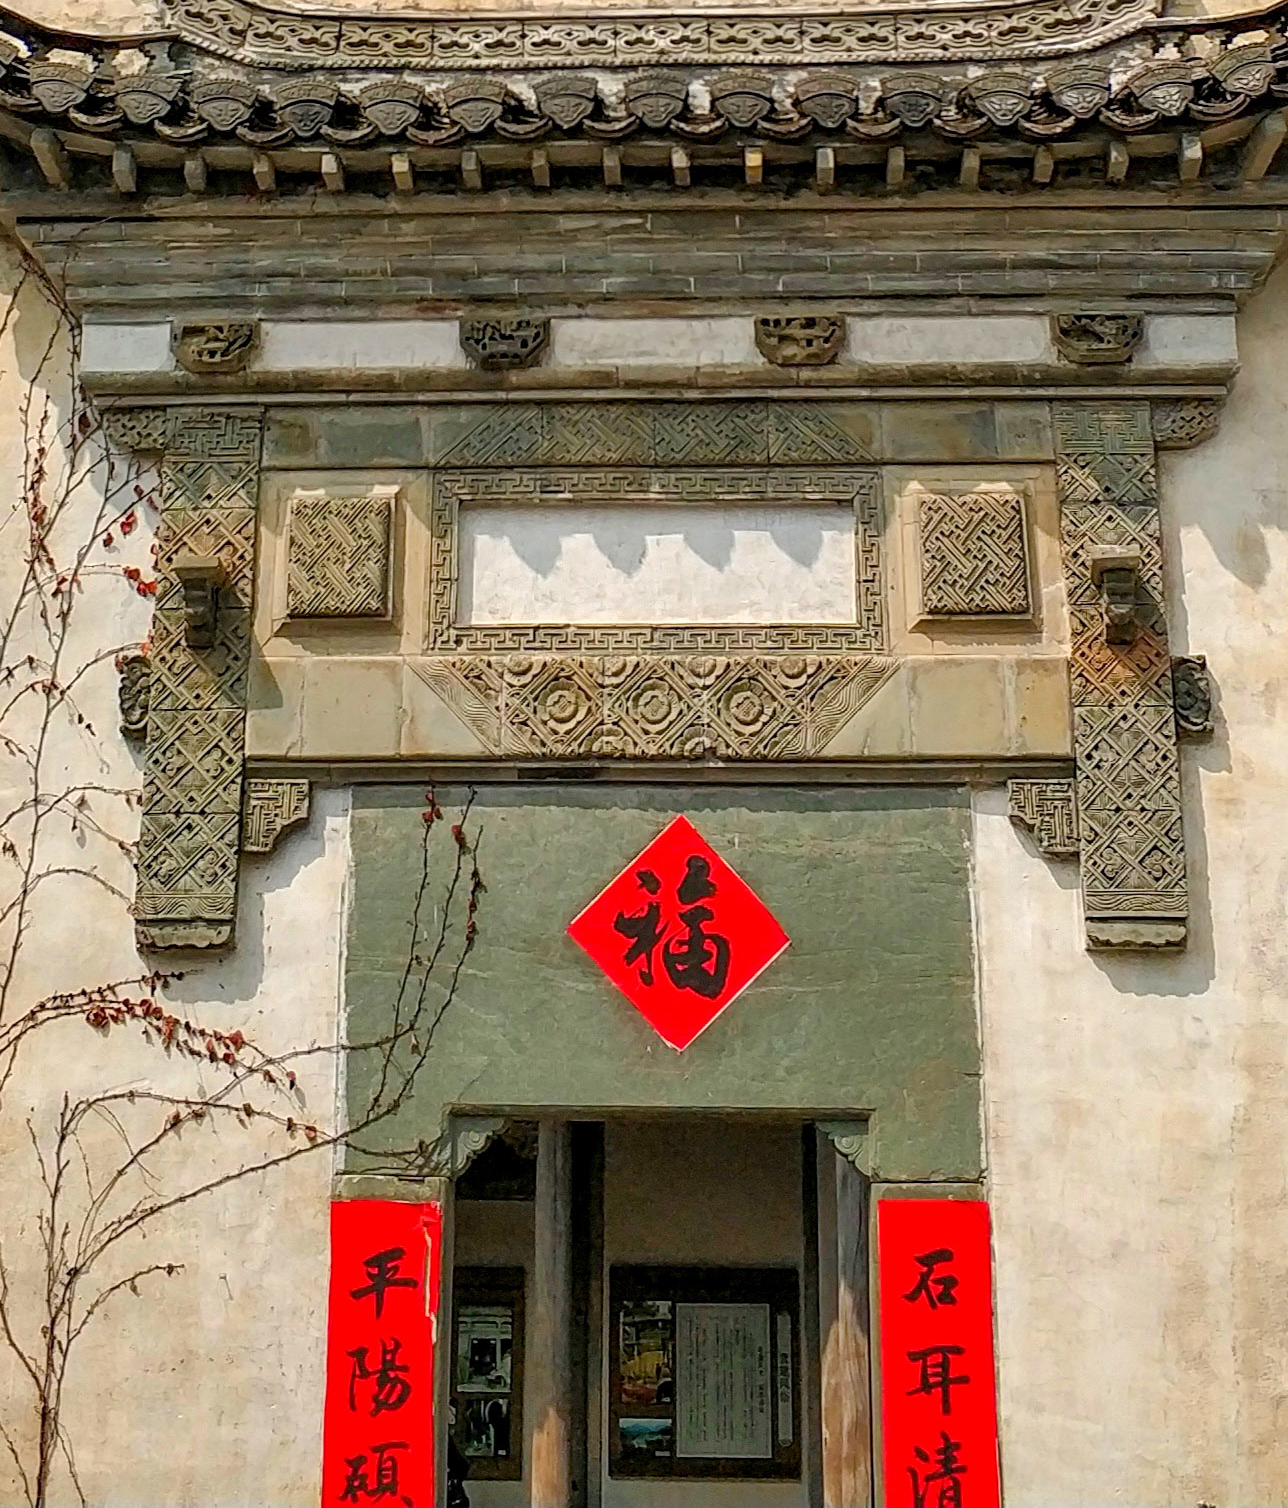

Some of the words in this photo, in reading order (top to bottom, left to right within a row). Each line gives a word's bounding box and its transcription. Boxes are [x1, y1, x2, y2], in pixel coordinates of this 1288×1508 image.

[614, 855, 732, 1001] 福
[902, 1248, 971, 1508] 石耳清
